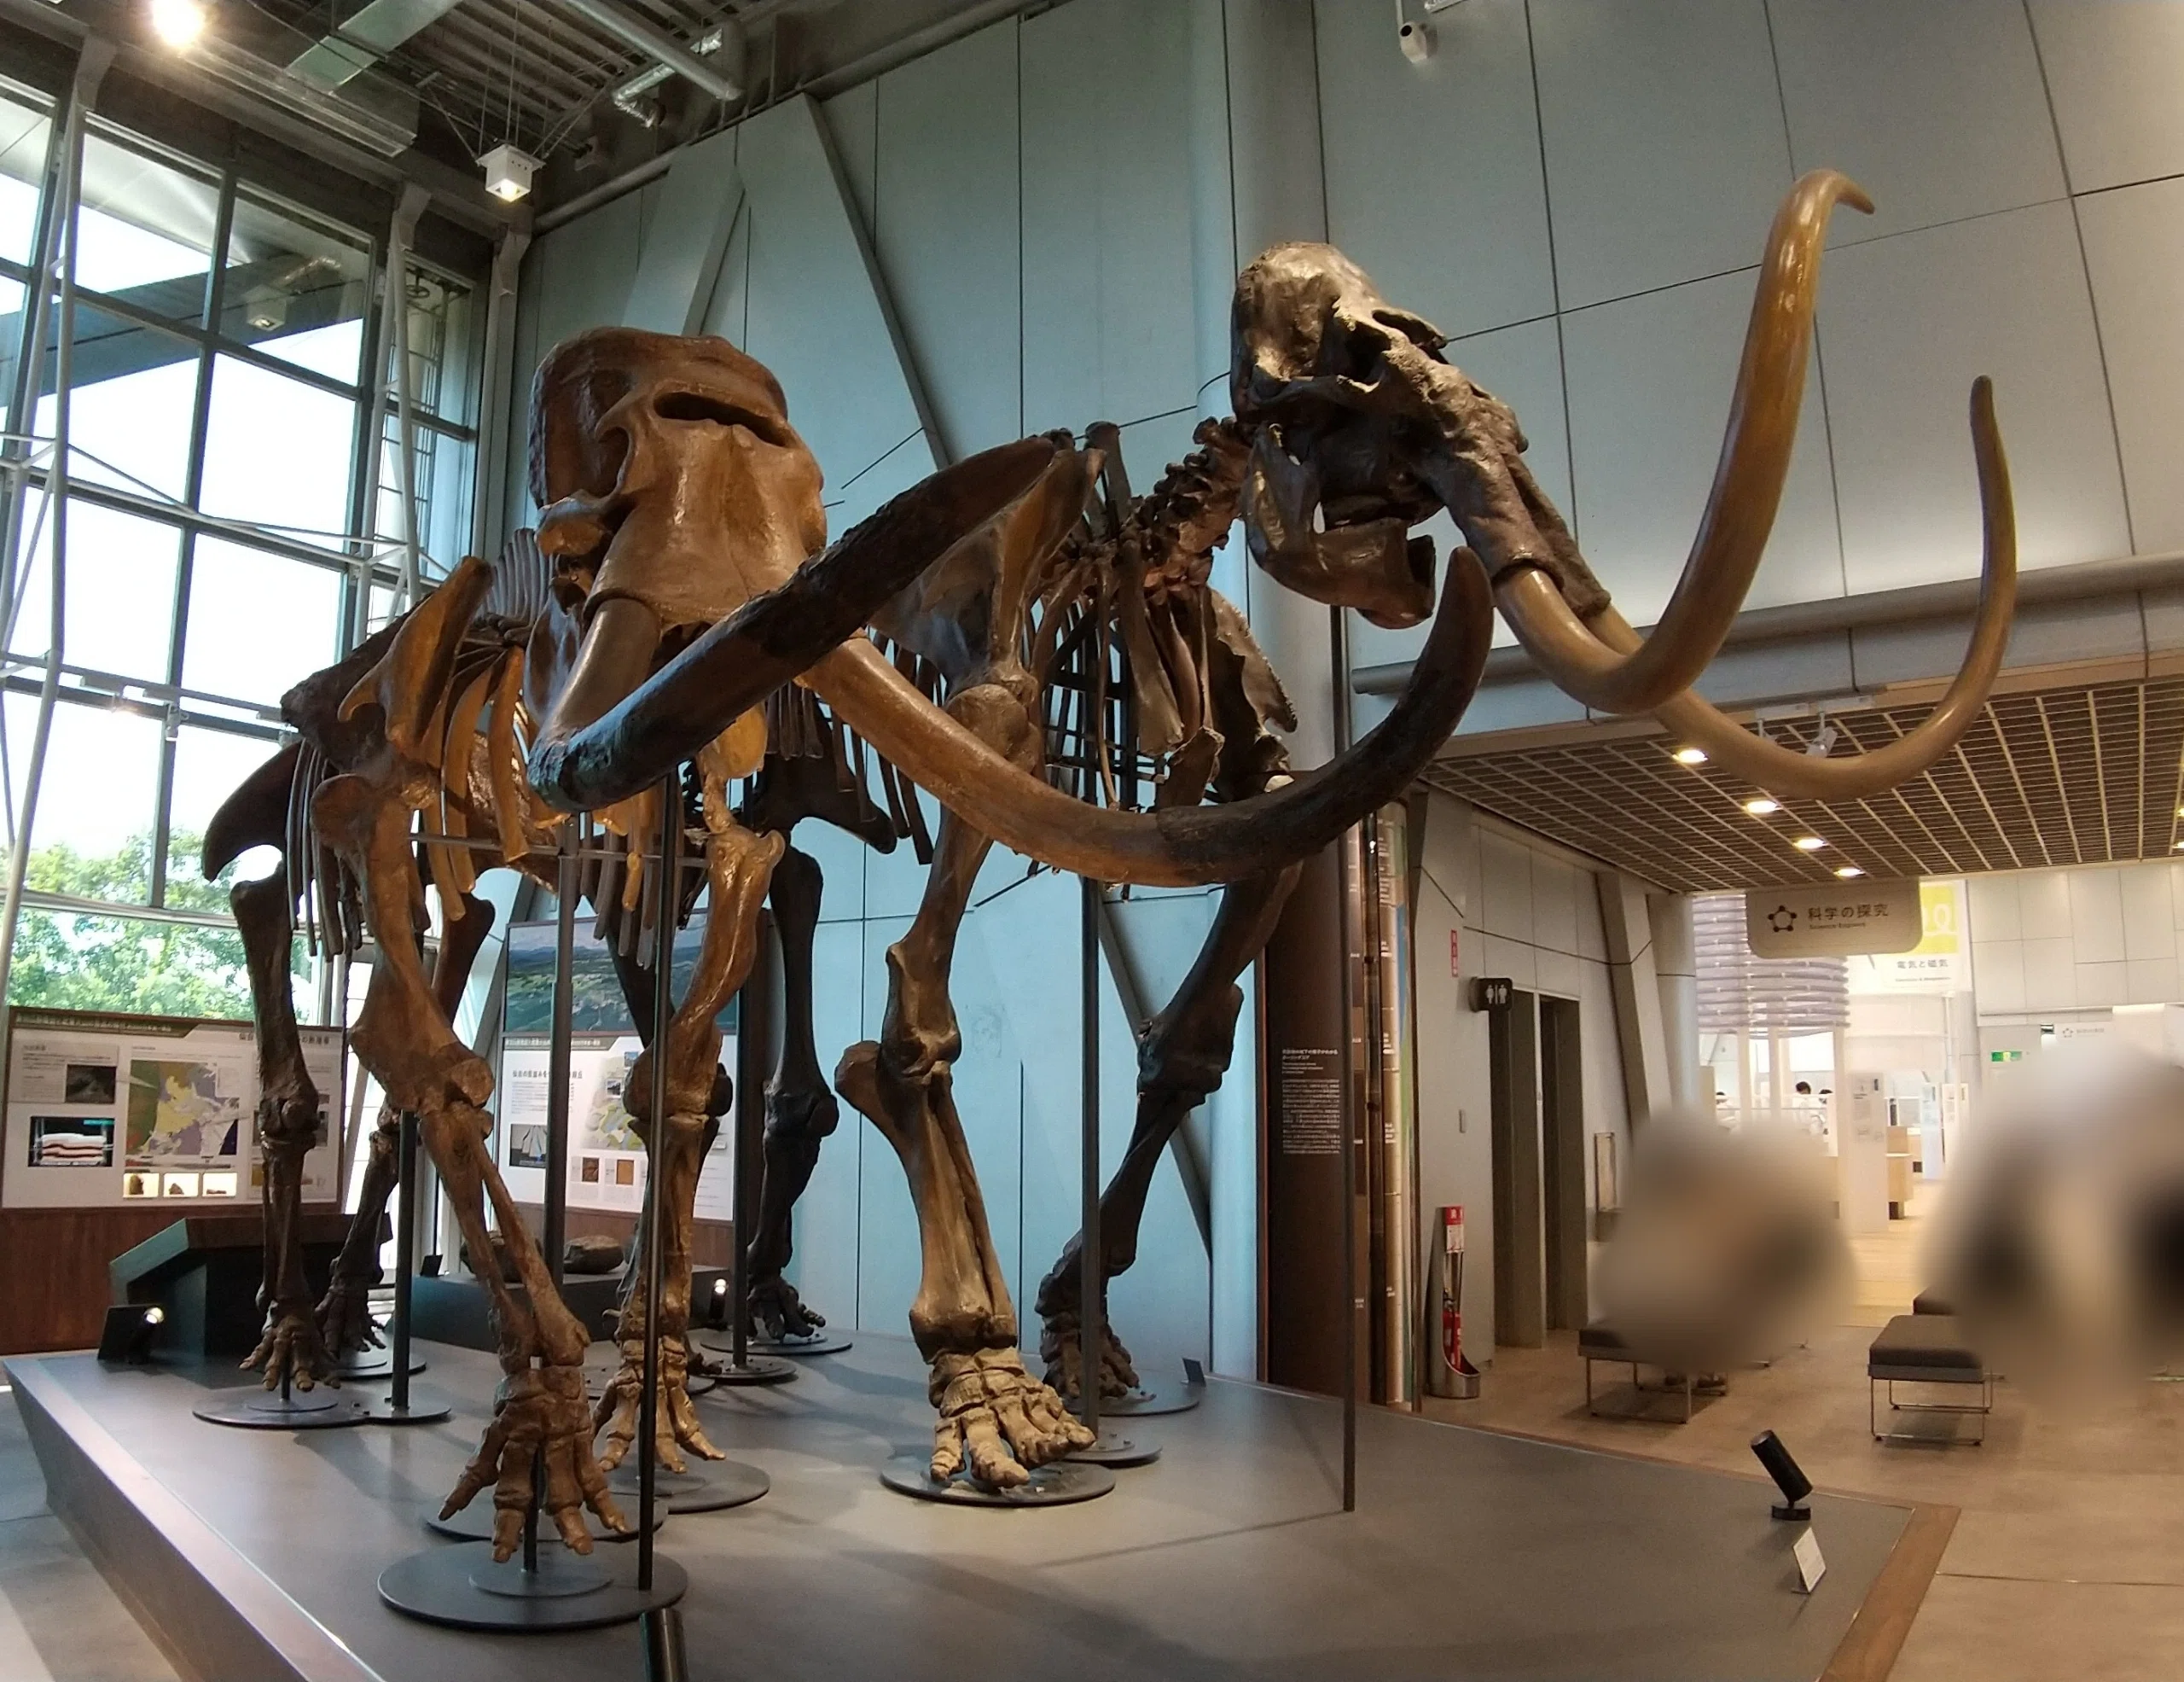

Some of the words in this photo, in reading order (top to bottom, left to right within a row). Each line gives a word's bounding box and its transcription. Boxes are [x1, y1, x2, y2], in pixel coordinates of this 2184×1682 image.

[1808, 904, 1889, 920] 科学の探究
